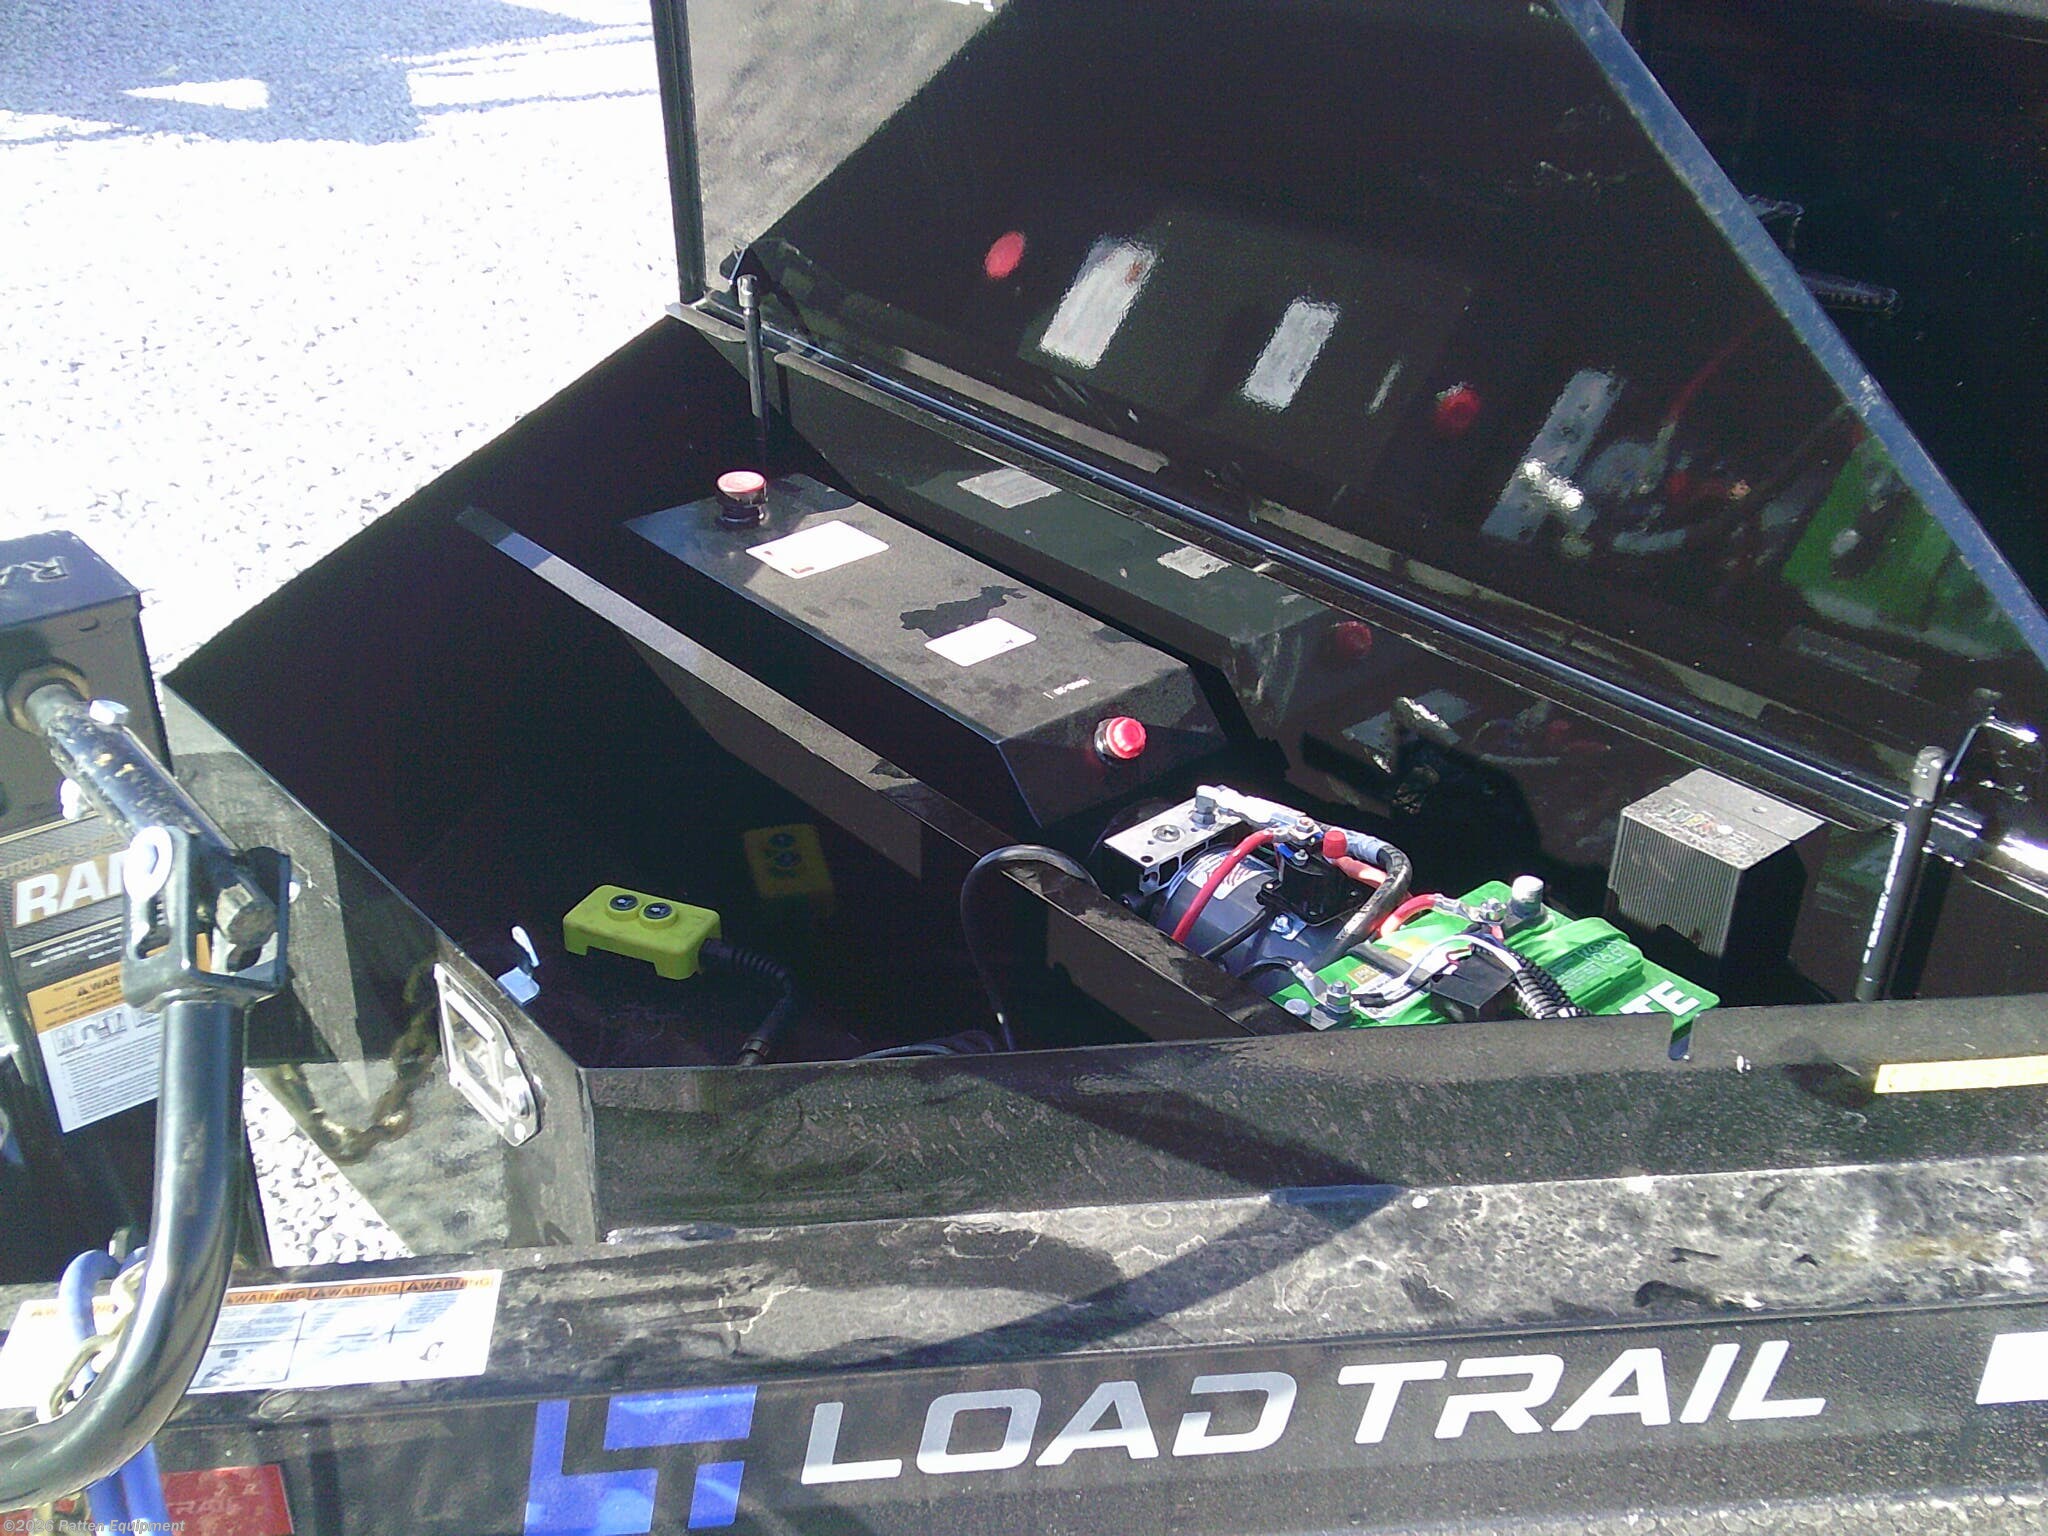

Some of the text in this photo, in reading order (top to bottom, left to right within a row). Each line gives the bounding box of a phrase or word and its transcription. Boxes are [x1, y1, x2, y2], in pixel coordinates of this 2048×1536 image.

[324, 1284, 400, 1299] WARNING
[417, 1276, 493, 1292] WARNING
[236, 1289, 307, 1303] WARNING
[800, 1340, 1826, 1485] LOAD TRAIL
